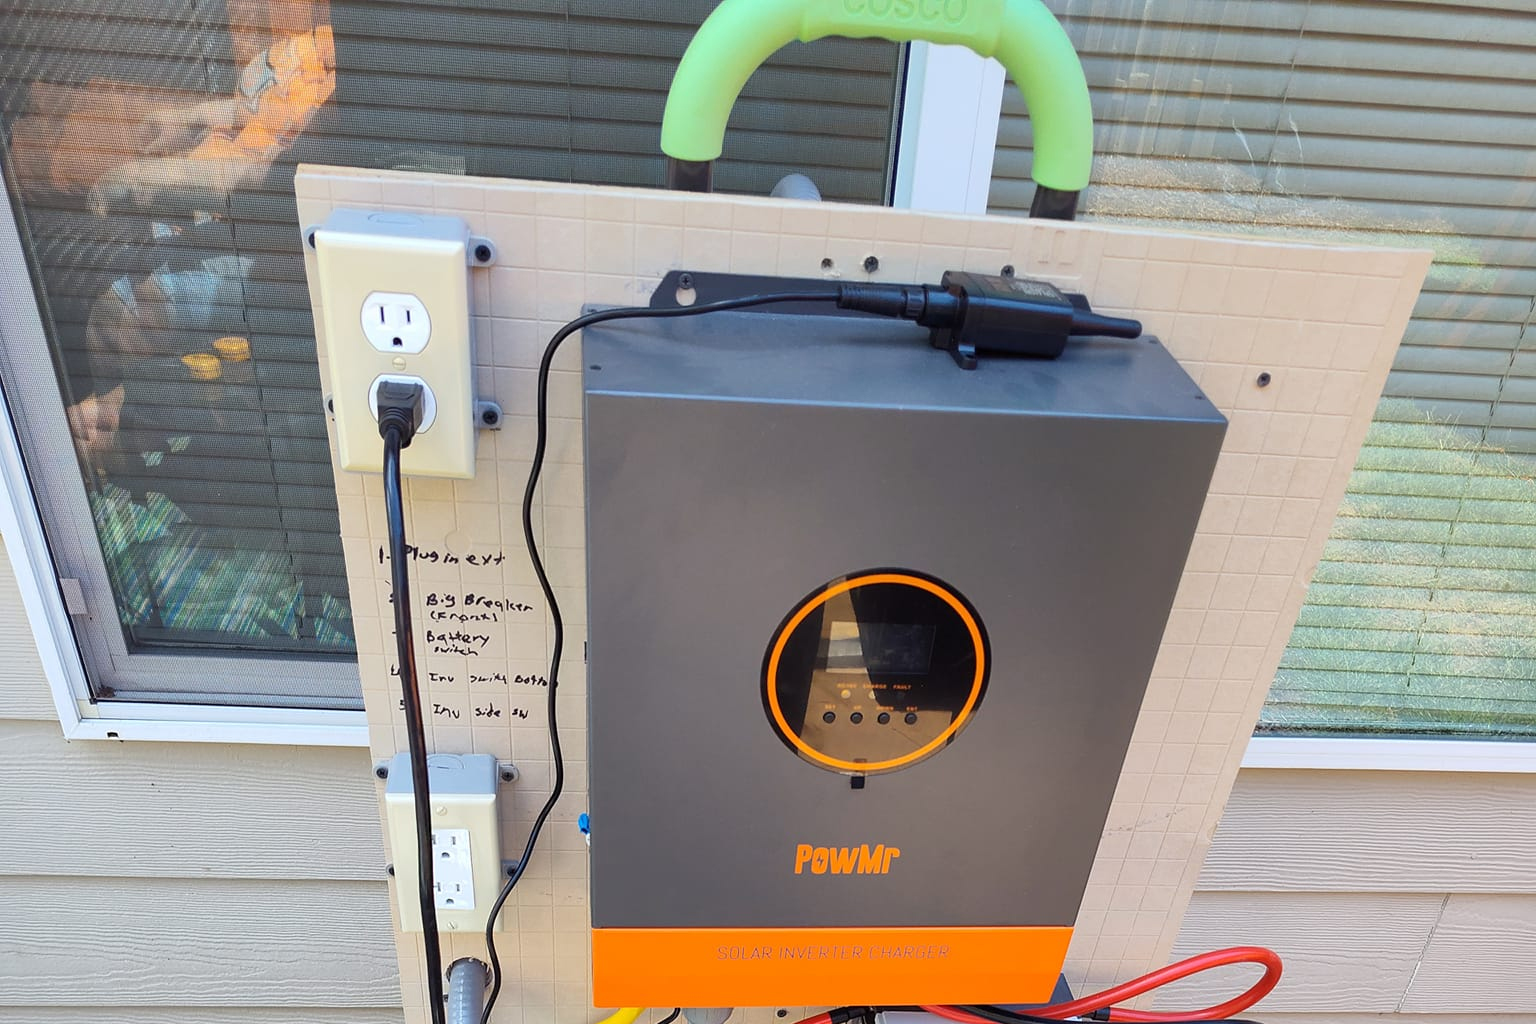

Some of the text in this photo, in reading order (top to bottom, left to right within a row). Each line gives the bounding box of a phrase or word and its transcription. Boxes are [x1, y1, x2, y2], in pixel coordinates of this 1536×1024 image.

[443, 553, 459, 564] in
[426, 593, 534, 612] Big Breaker
[426, 630, 490, 647] Battery
[794, 844, 900, 875] PowMr
[717, 943, 950, 960] SOLAR INVERTER CHARGER
